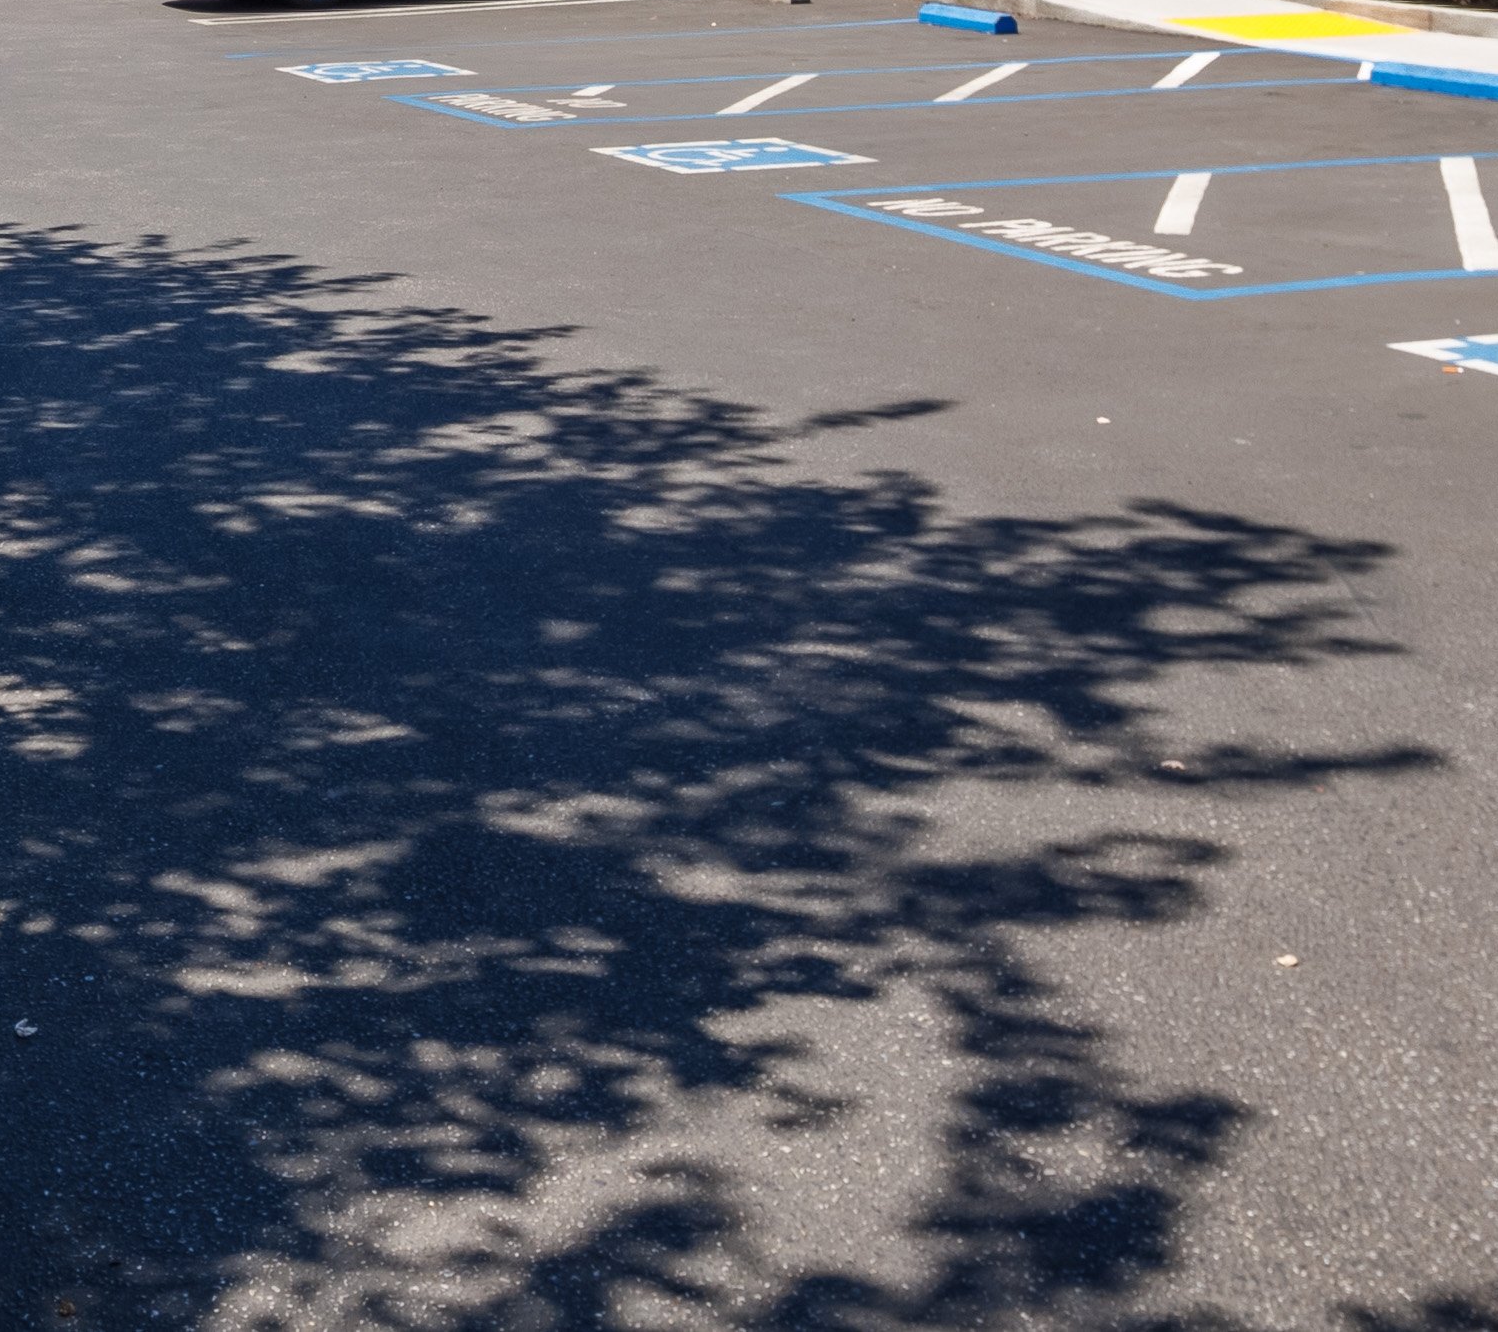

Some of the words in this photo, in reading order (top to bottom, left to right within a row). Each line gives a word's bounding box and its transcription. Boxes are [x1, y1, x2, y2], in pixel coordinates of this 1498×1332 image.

[428, 93, 578, 122] PARKING
[866, 197, 985, 217] NO
[957, 217, 1244, 278] PARKING
